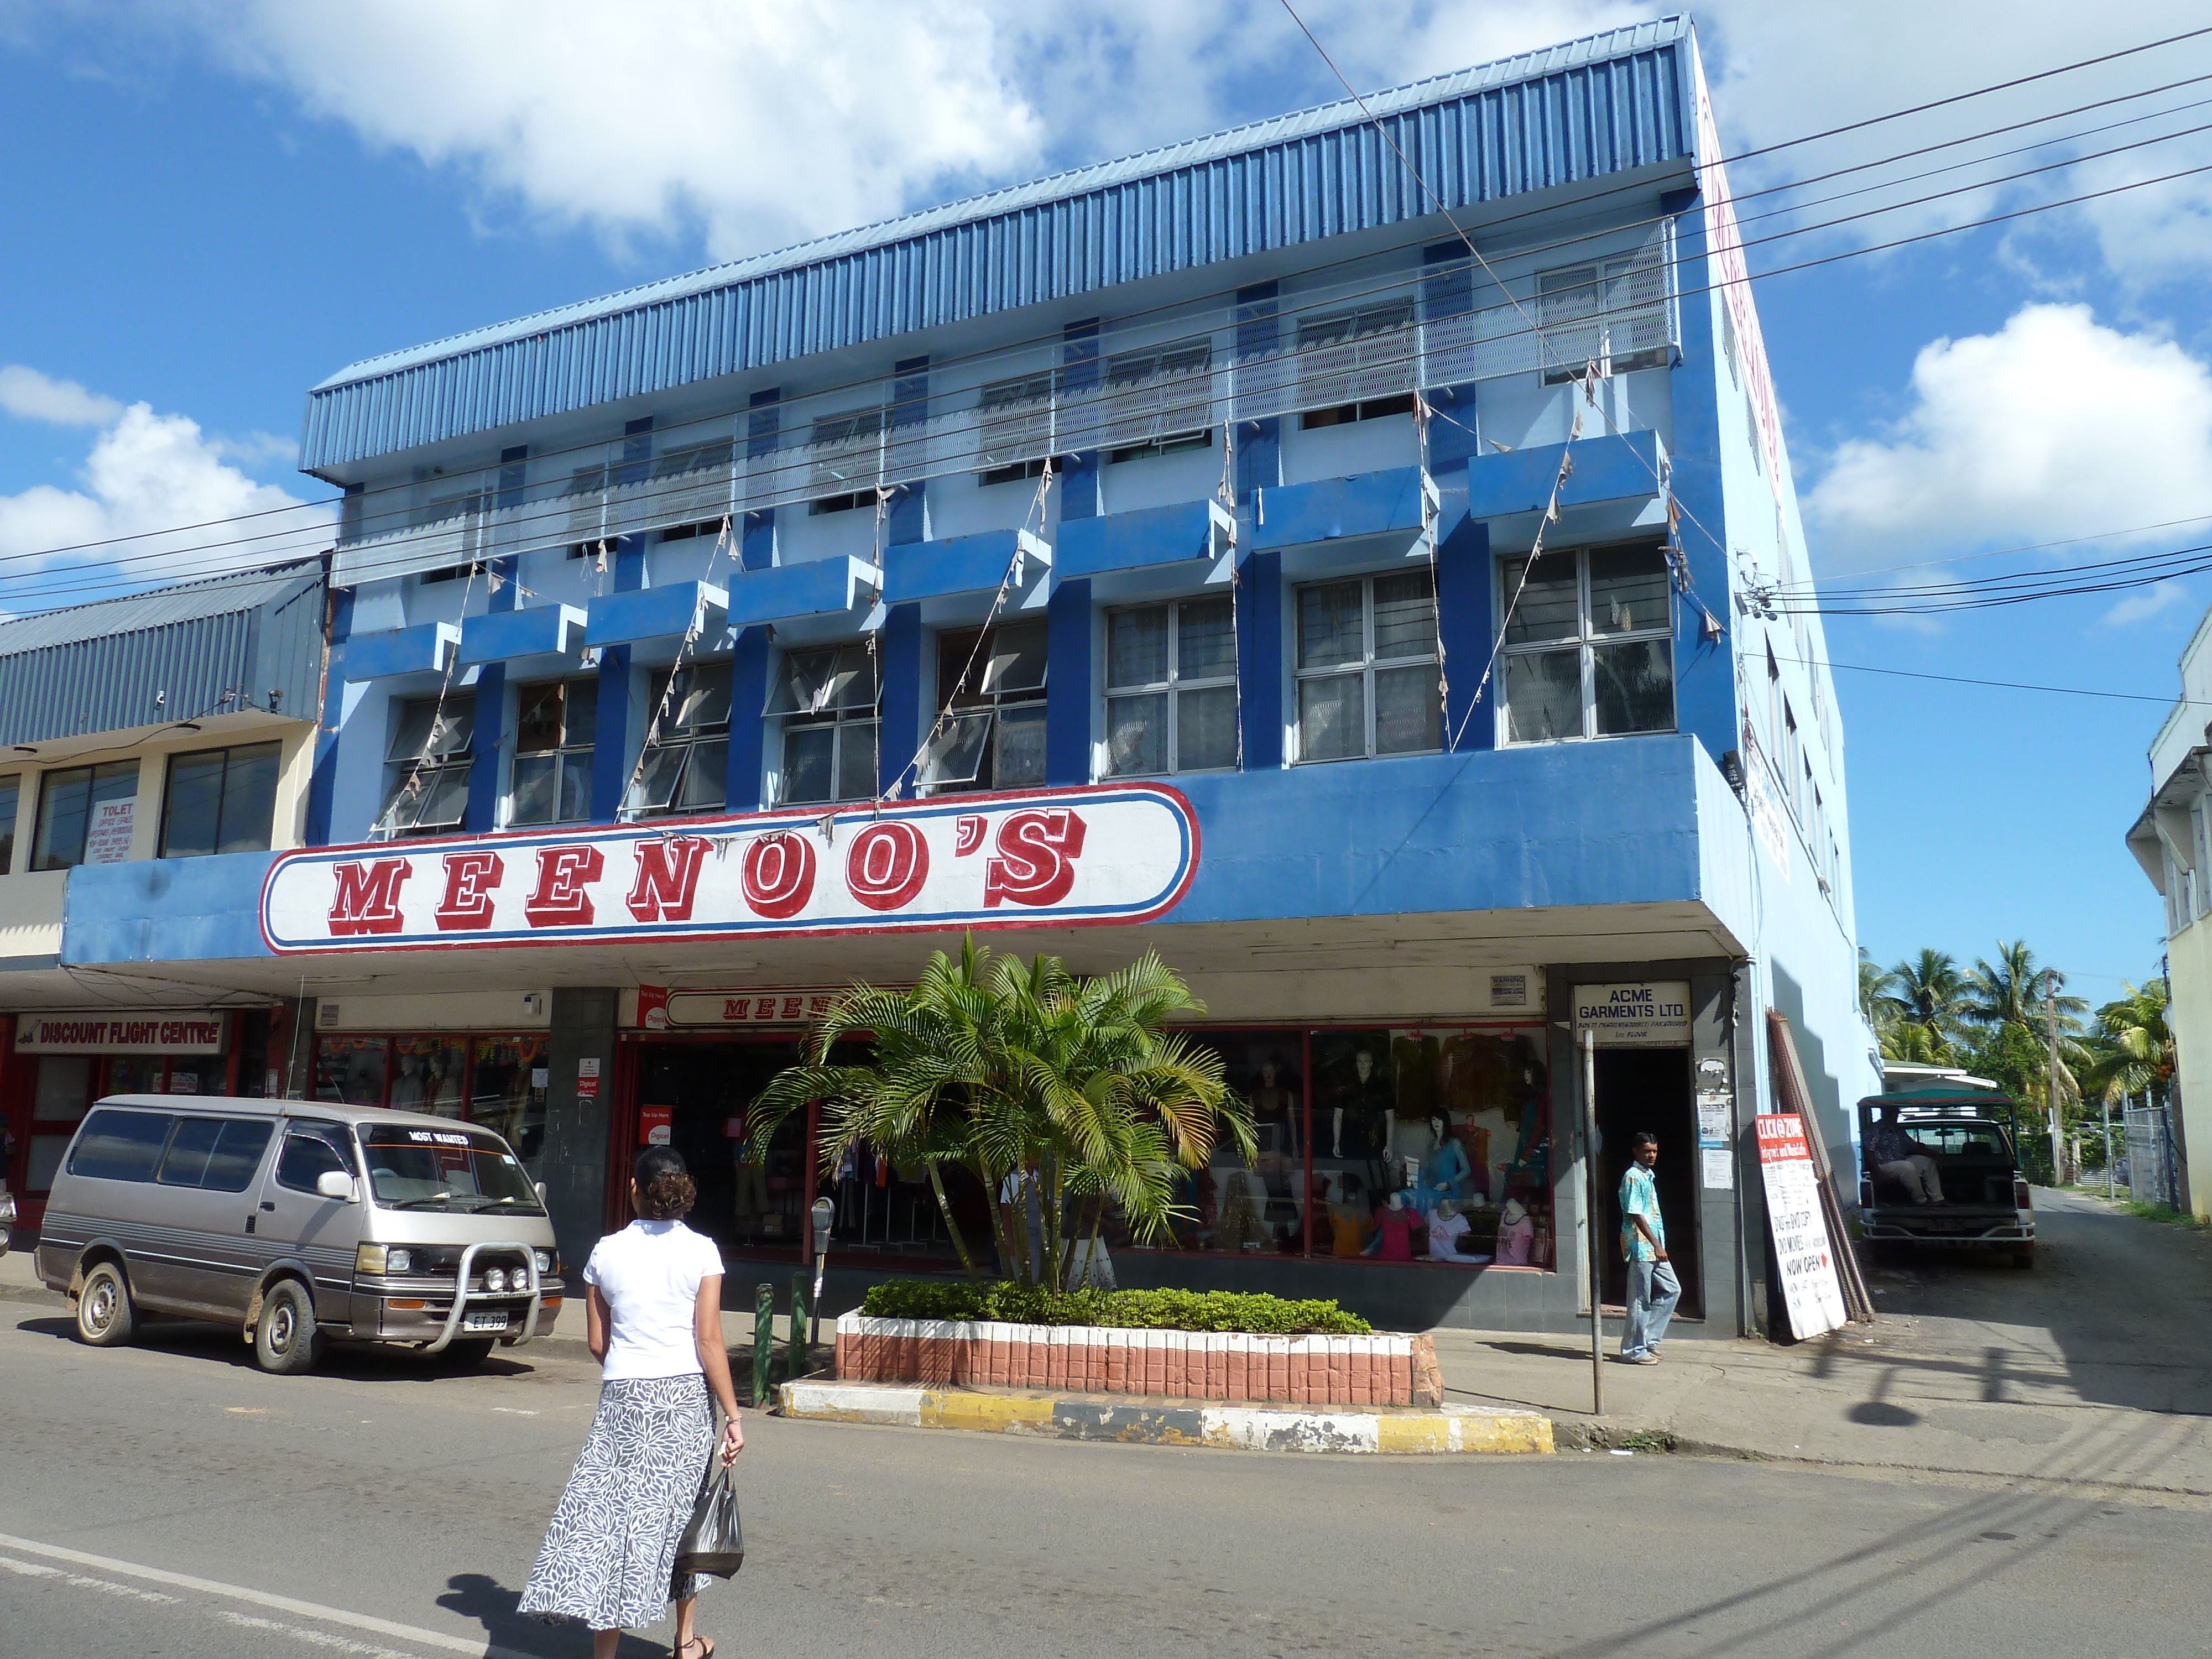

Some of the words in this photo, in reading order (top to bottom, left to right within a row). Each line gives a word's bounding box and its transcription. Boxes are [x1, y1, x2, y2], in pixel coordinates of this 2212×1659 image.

[327, 807, 1087, 935] MEENOO'S
[1609, 989, 1652, 1003] ACME
[1579, 1005, 1654, 1019] GARMENTS
[40, 1022, 107, 1044] DISCOUNT
[108, 1022, 159, 1044] FLIGHT
[160, 1022, 220, 1044] CENTRE
[409, 1131, 432, 1142] MOST
[433, 1133, 468, 1145] WANTED
[1787, 1259, 1802, 1277] NOW
[1804, 1255, 1820, 1274] OPEN
[473, 1316, 487, 1329] ET
[489, 1316, 506, 1328] 399
